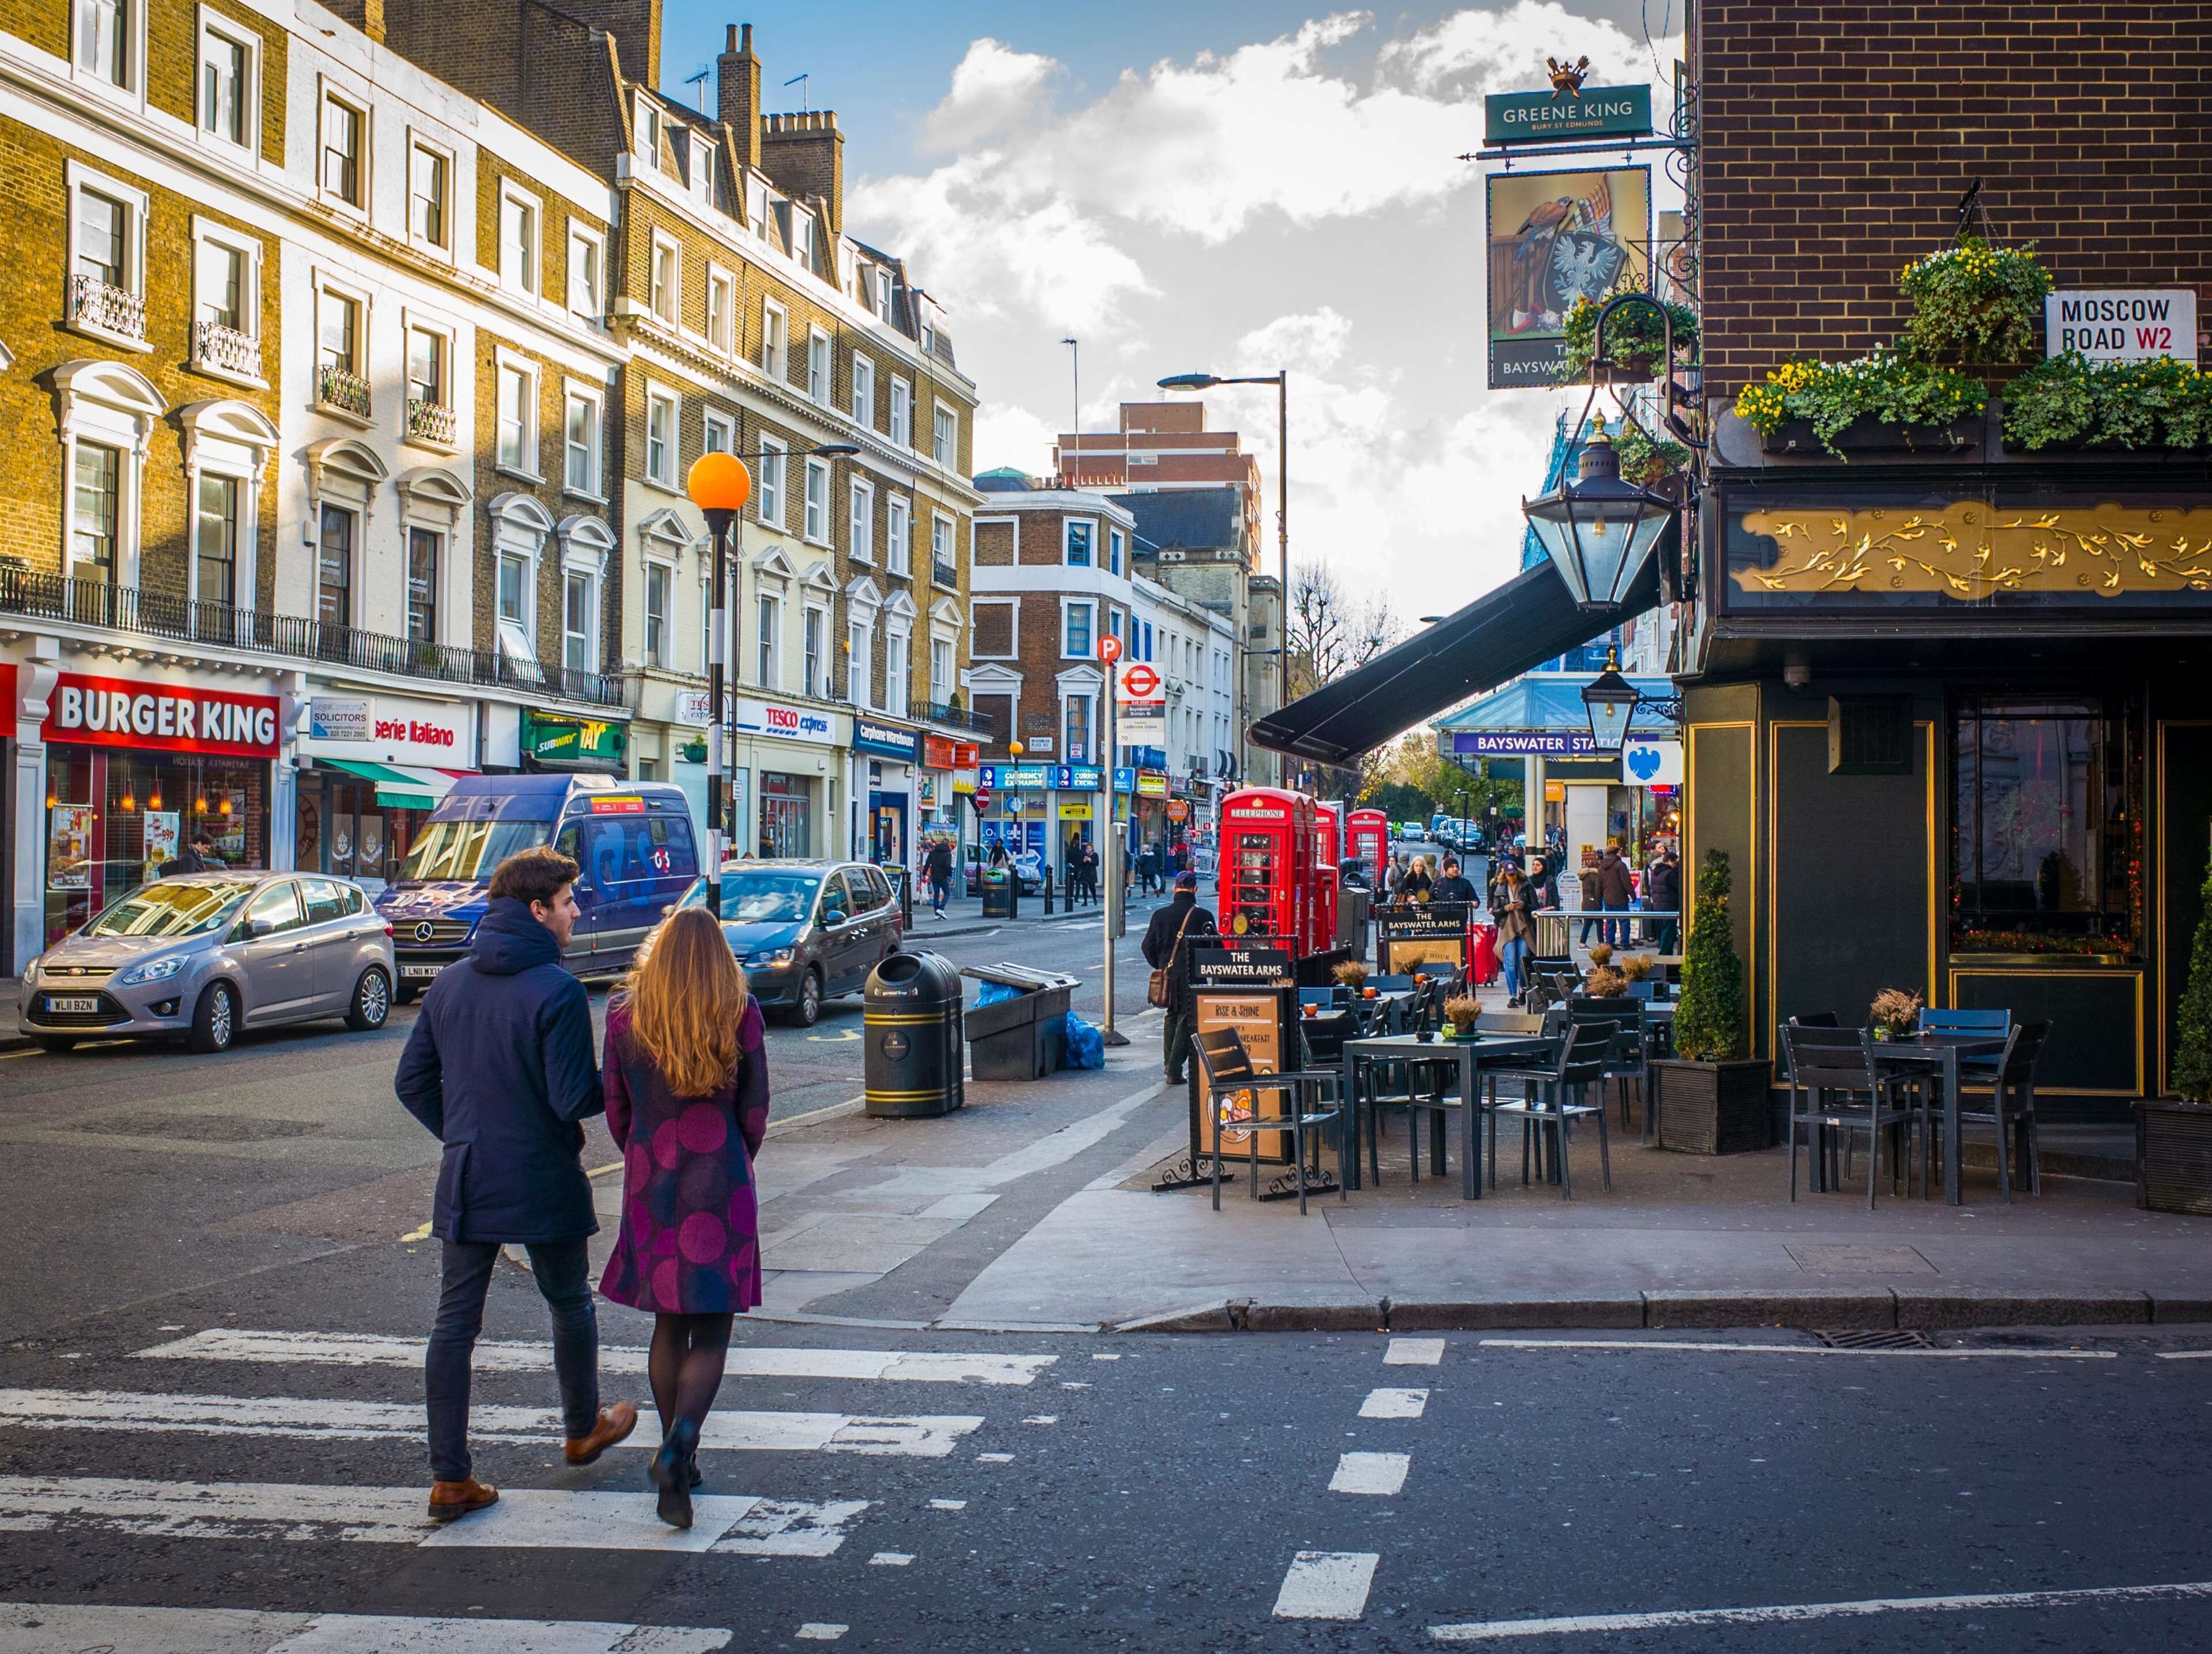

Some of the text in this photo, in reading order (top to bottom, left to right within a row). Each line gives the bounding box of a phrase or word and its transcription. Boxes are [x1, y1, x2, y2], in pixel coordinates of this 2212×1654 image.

[1503, 101, 1632, 123] GREENE KING
[1566, 120, 1603, 128] EDMUNDS
[2062, 299, 2170, 322] MOSCOW
[2062, 327, 2172, 350] ROAD W2
[1103, 640, 1116, 659] P
[62, 686, 275, 745] BURGER KING
[314, 713, 366, 722] SOLICITORS
[766, 708, 827, 735] TESCO express
[410, 720, 453, 747] Italiano
[538, 732, 578, 753] SUBWAY
[860, 724, 914, 747] Carphone Warehouse
[1478, 738, 1564, 749] BAYSWATER
[1231, 952, 1250, 962] THE
[1201, 965, 1282, 976] BAYSWATER ARMS
[55, 1000, 92, 1010] WL11 BZN
[1216, 1005, 1260, 1018] RISE & SHINE
